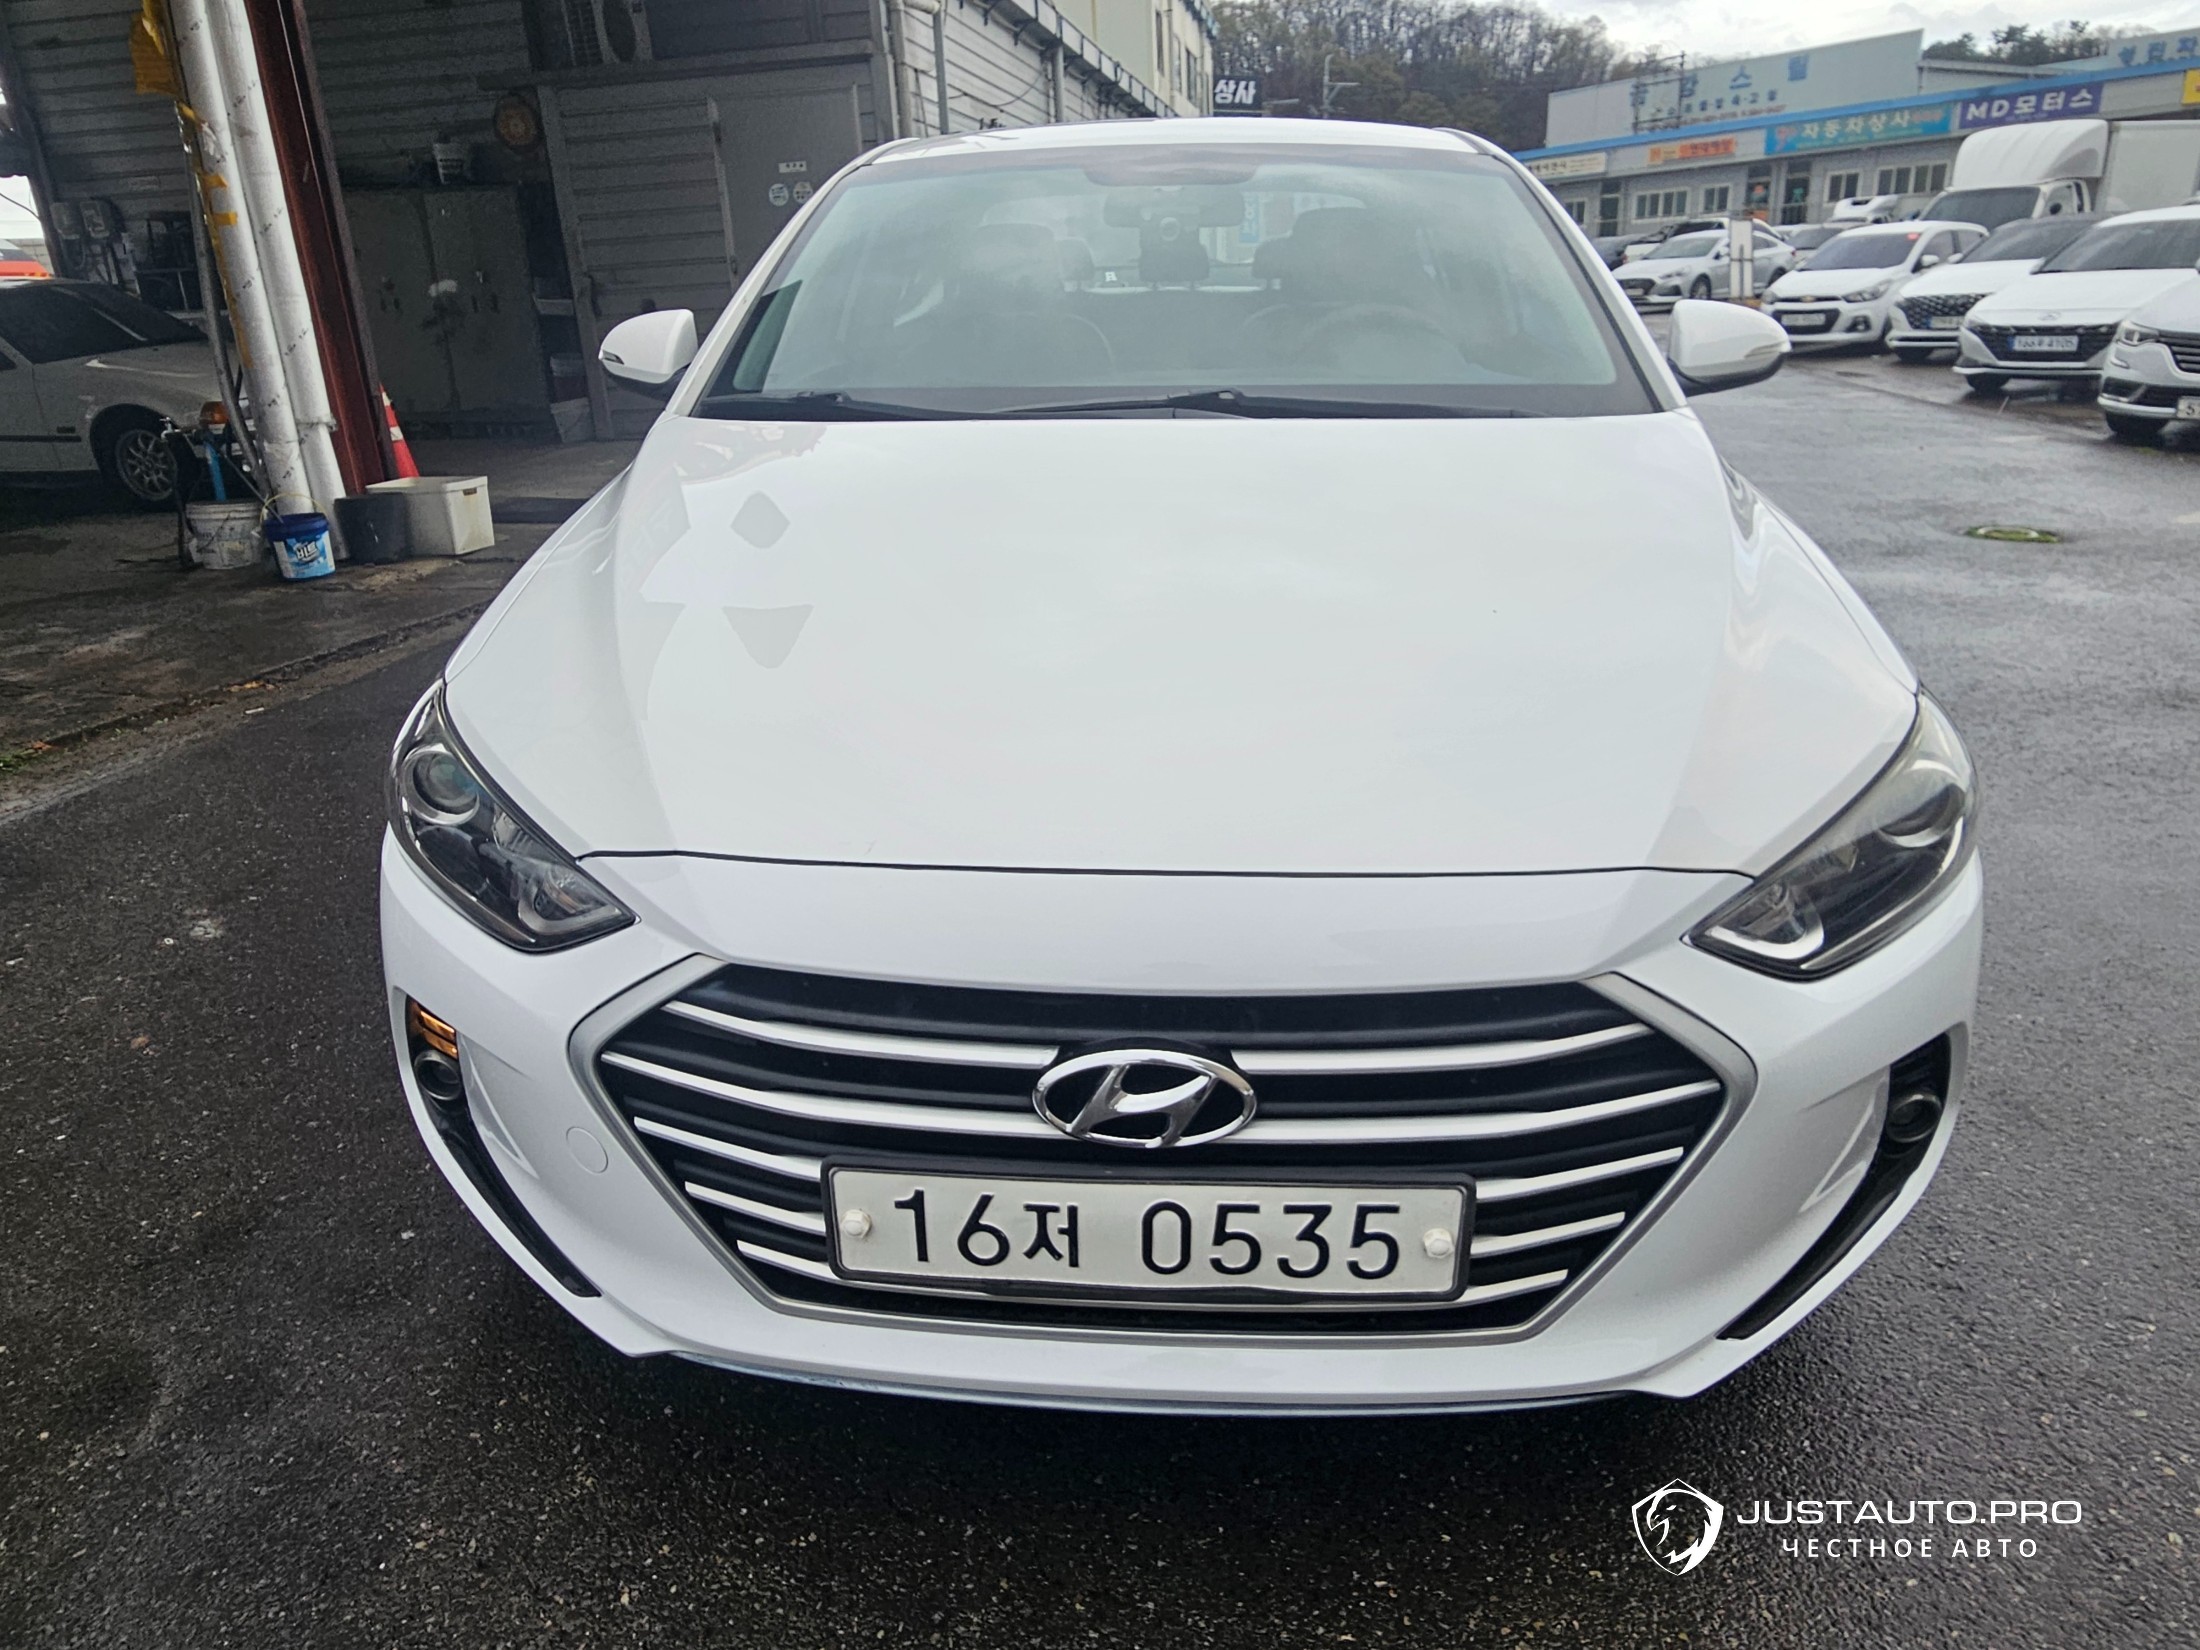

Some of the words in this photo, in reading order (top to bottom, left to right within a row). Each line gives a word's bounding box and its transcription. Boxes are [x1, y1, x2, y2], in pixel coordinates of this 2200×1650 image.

[1213, 79, 1257, 105] 상사
[1965, 88, 2094, 122] MD모터스
[894, 1190, 1079, 1268] 16저
[1141, 1200, 1402, 1279] 0535
